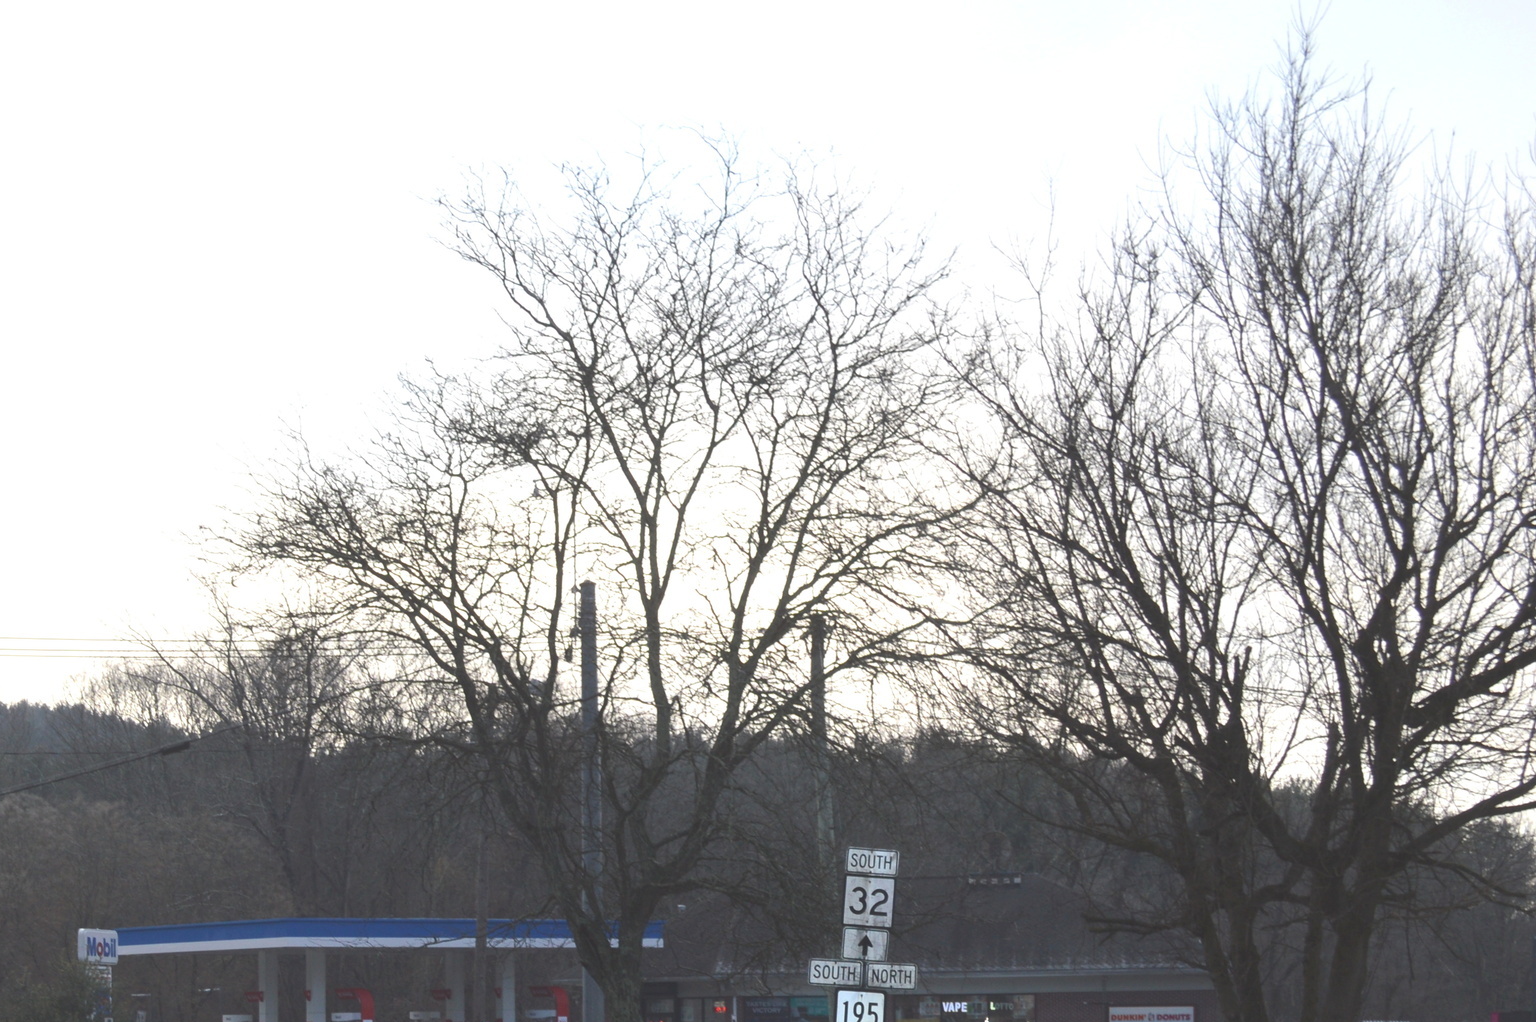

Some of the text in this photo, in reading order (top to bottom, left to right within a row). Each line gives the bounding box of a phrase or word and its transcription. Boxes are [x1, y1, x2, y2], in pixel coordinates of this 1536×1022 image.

[850, 852, 893, 870] SOUTH
[848, 886, 889, 917] 32
[86, 935, 117, 958] Mobil
[812, 963, 857, 982] SOUTH
[870, 968, 913, 985] NORTH
[942, 1001, 968, 1013] VAPE
[1110, 1013, 1191, 1021] DUNKIN' DONUTS
